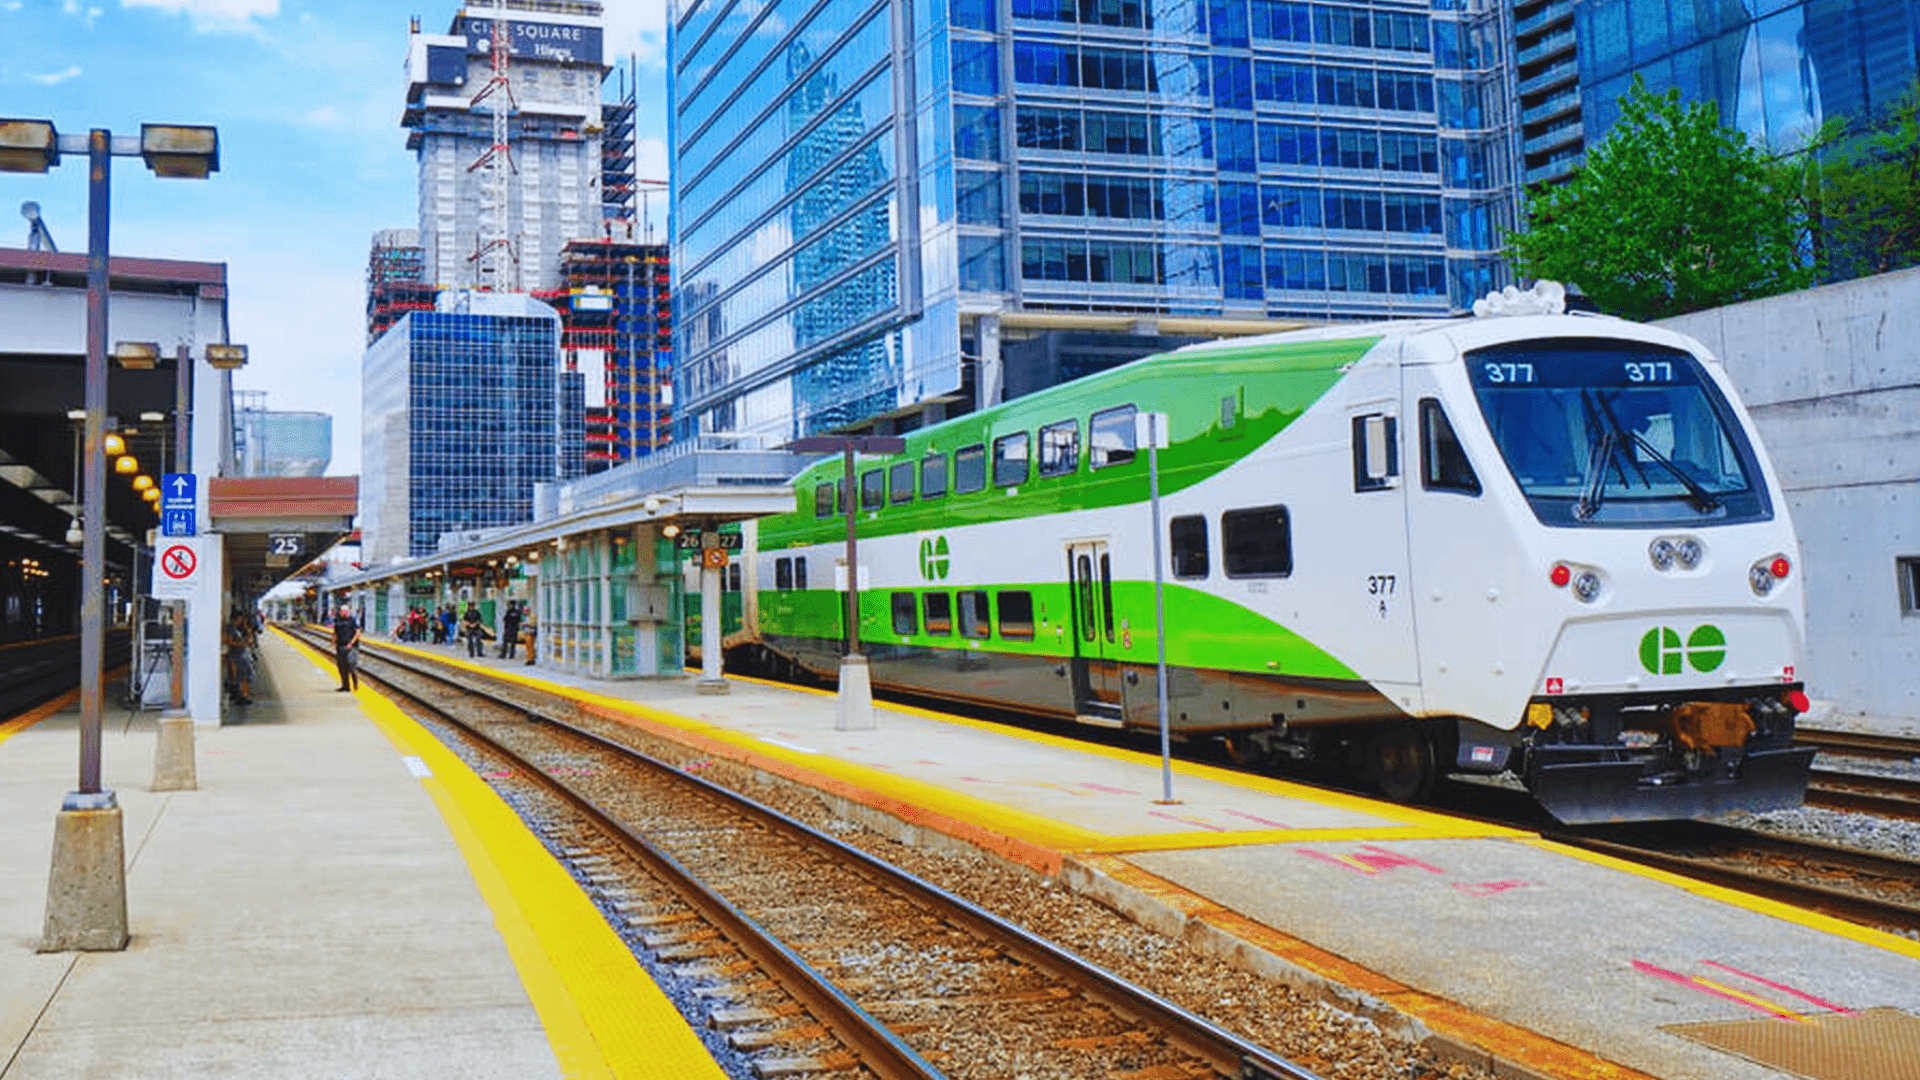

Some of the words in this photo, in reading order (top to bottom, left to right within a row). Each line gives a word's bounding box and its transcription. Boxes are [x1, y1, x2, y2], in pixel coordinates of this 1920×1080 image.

[471, 20, 508, 36] CI
[516, 24, 581, 41] SQUARE
[1485, 362, 1533, 383] 377
[1624, 361, 1672, 382] 377
[275, 537, 298, 555] 25
[681, 534, 699, 548] 26
[721, 534, 737, 548] 27
[919, 535, 950, 581] GO
[1368, 575, 1395, 595] 377
[1638, 624, 1728, 676] GO
